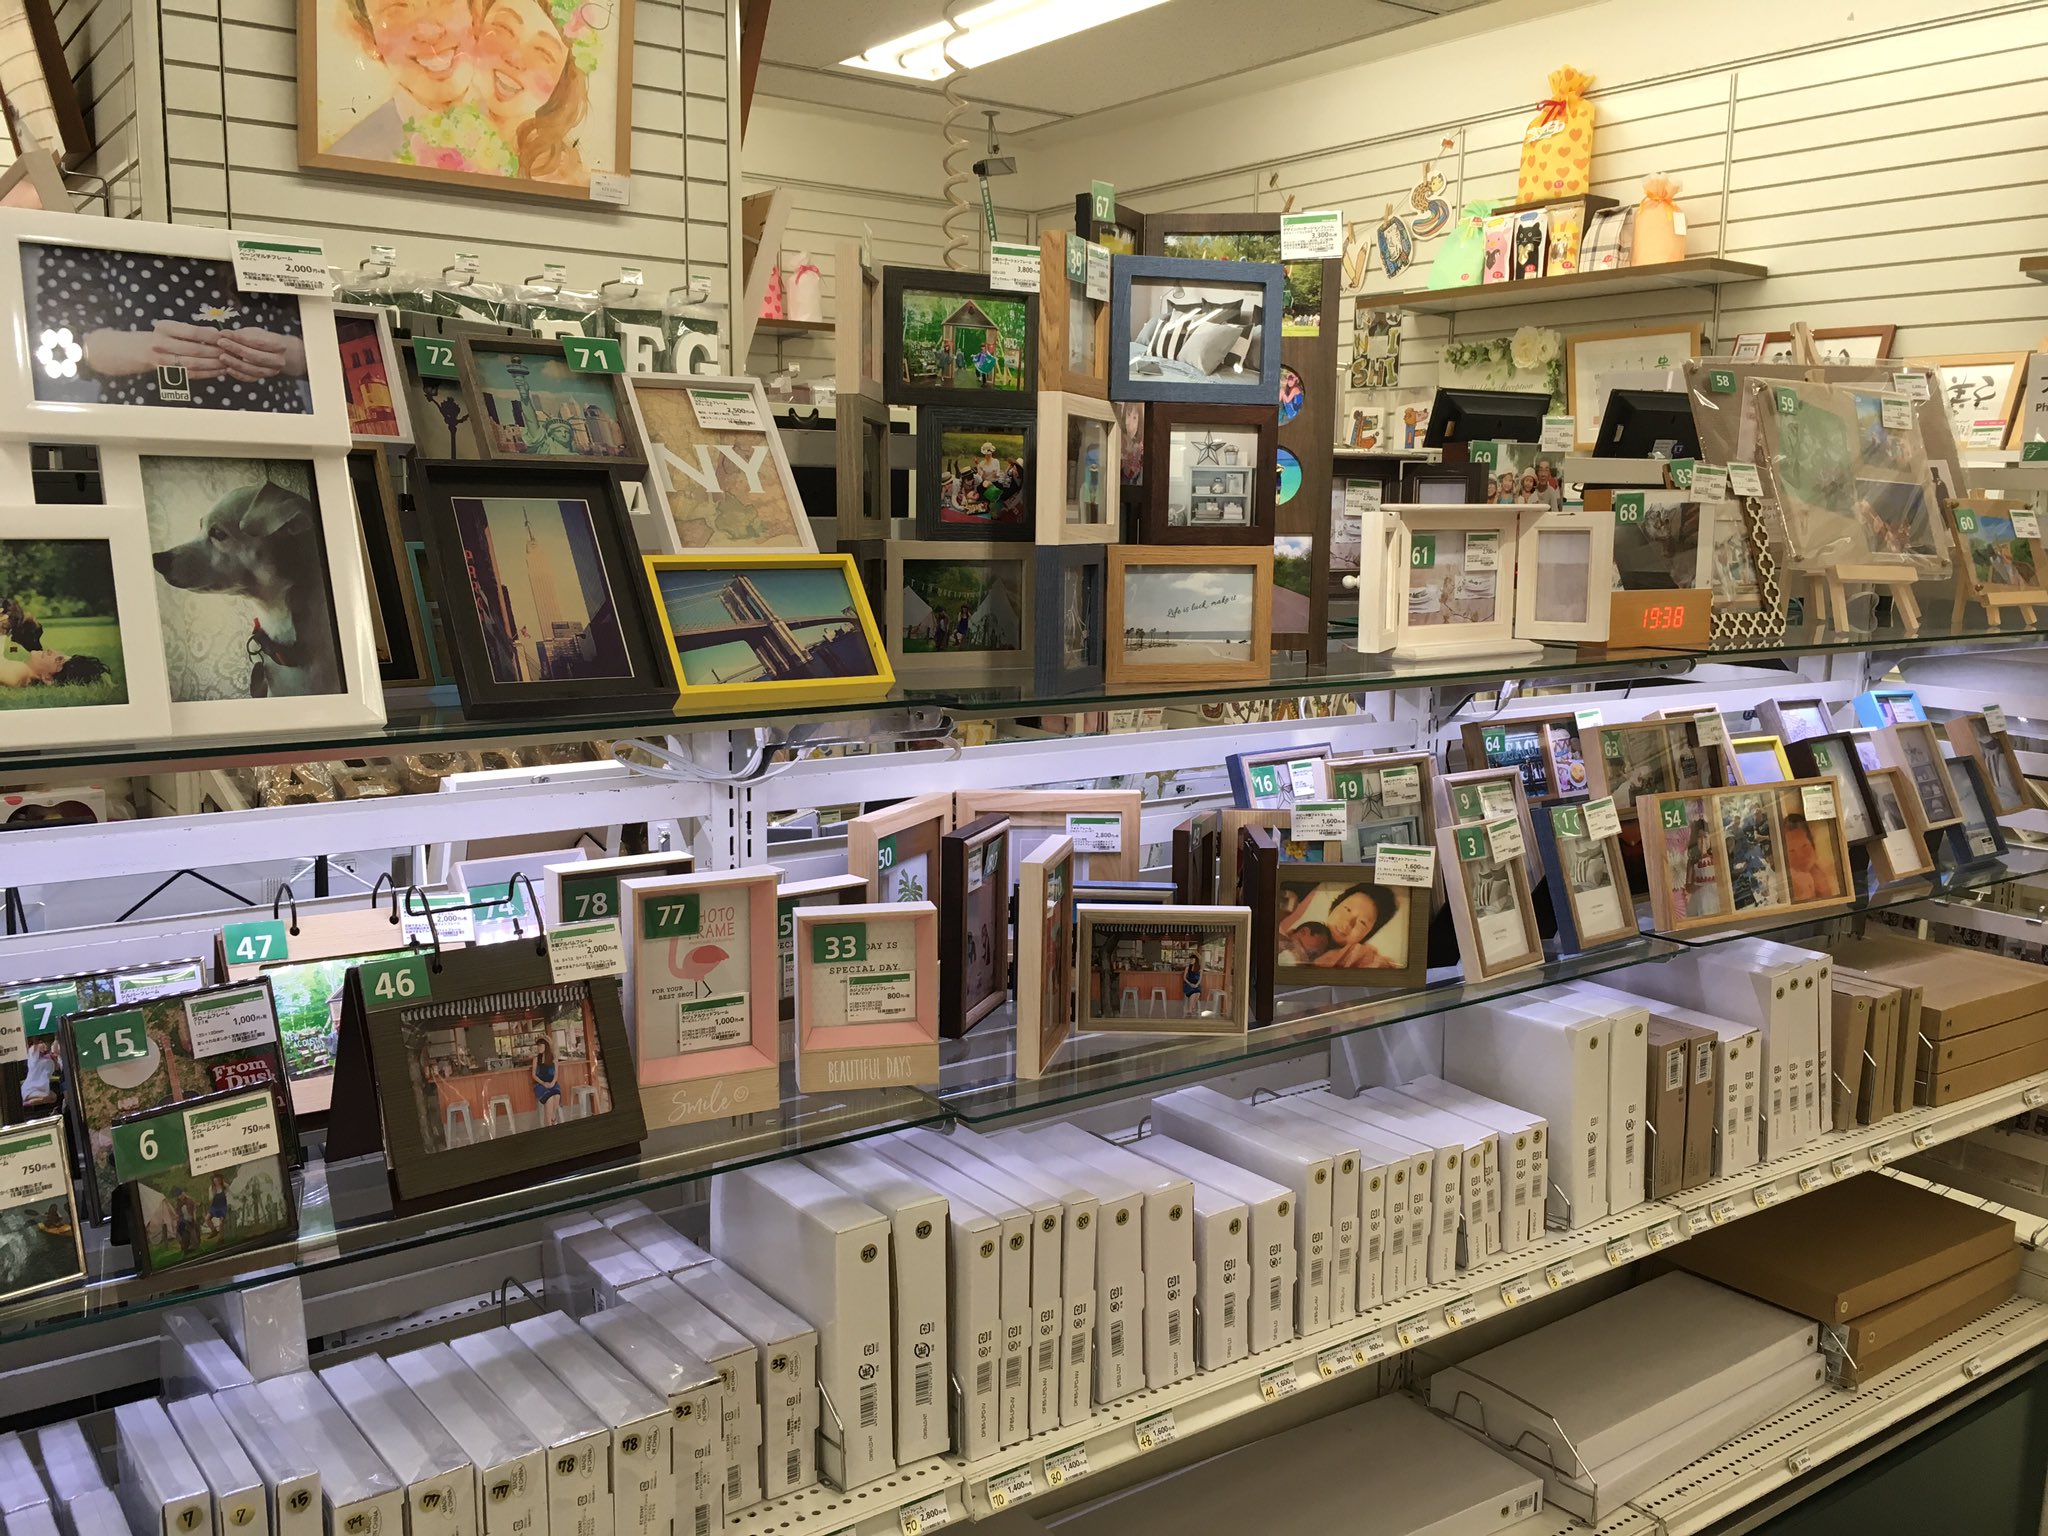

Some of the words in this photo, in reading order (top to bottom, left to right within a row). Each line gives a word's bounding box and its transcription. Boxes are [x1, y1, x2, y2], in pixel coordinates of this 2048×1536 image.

[1096, 195, 1109, 218] 67
[1070, 249, 1081, 276] 39
[426, 346, 455, 366] 72
[574, 348, 608, 369] 71
[1716, 375, 1730, 387] 58
[161, 391, 190, 400] umbra
[1781, 397, 1794, 412] 59
[1474, 452, 1492, 463] 69
[650, 443, 770, 493] NY
[1676, 469, 1692, 485] 83
[1619, 503, 1638, 522] 68
[1960, 517, 1974, 531] 60
[1412, 547, 1428, 565] 61
[1642, 606, 1685, 630] 19:38
[1485, 736, 1501, 752] 64
[1604, 741, 1619, 757] 63
[1254, 775, 1273, 792] 16
[1339, 780, 1358, 798] 19
[1460, 793, 1470, 809] 9
[1665, 810, 1682, 828] 54
[1467, 837, 1477, 856] 3
[878, 845, 892, 870] 50
[481, 896, 516, 918] 74
[575, 892, 608, 918] 78
[657, 904, 685, 927] 77
[700, 906, 735, 924] HOTO
[689, 922, 735, 940] RAME
[236, 934, 273, 960] 47
[825, 936, 857, 960] 33
[866, 942, 882, 950] DAY
[887, 941, 898, 949] IS
[829, 965, 876, 975] SPECIAL
[374, 968, 415, 1000] 46
[666, 985, 684, 993] YOUR
[658, 992, 676, 1000] BEST
[677, 991, 695, 999] SHOT
[33, 1002, 53, 1030] 7
[192, 1011, 230, 1021] クロームフレーム
[94, 1028, 135, 1060] 15
[212, 1060, 268, 1082] From
[828, 1058, 881, 1084] BEAUTIFUL
[887, 1055, 912, 1079] DAYS
[224, 1069, 276, 1090] Dusk
[667, 1080, 732, 1124] Smile
[191, 1123, 232, 1136] クロームフレーム
[139, 1129, 160, 1161] 6
[1342, 1160, 1352, 1173] 19
[1418, 1162, 1426, 1175] 9
[1170, 1207, 1181, 1219] 48
[1043, 1218, 1055, 1230] 80
[1078, 1216, 1089, 1227] 80
[917, 1224, 931, 1237] 50
[981, 1243, 993, 1255] 70
[1011, 1236, 1022, 1248] 70
[862, 1247, 877, 1260] 50
[1552, 1277, 1558, 1287] 3
[1507, 1294, 1512, 1304] 1
[1449, 1316, 1456, 1326] 9
[1403, 1335, 1409, 1344] 8
[772, 1357, 787, 1370] 35
[1354, 1351, 1364, 1362] 19
[1322, 1366, 1332, 1376] 16
[675, 1404, 692, 1418] 32
[622, 1437, 639, 1452] 78
[1140, 1434, 1152, 1447] 48
[558, 1457, 575, 1473] 78
[1050, 1470, 1062, 1484] 80
[492, 1484, 510, 1500] 77
[423, 1494, 441, 1508] 77
[992, 1494, 1004, 1507] 70
[182, 1509, 195, 1527] 7
[236, 1508, 248, 1524] 7
[347, 1514, 365, 1530] 74
[905, 1519, 918, 1534] 50
